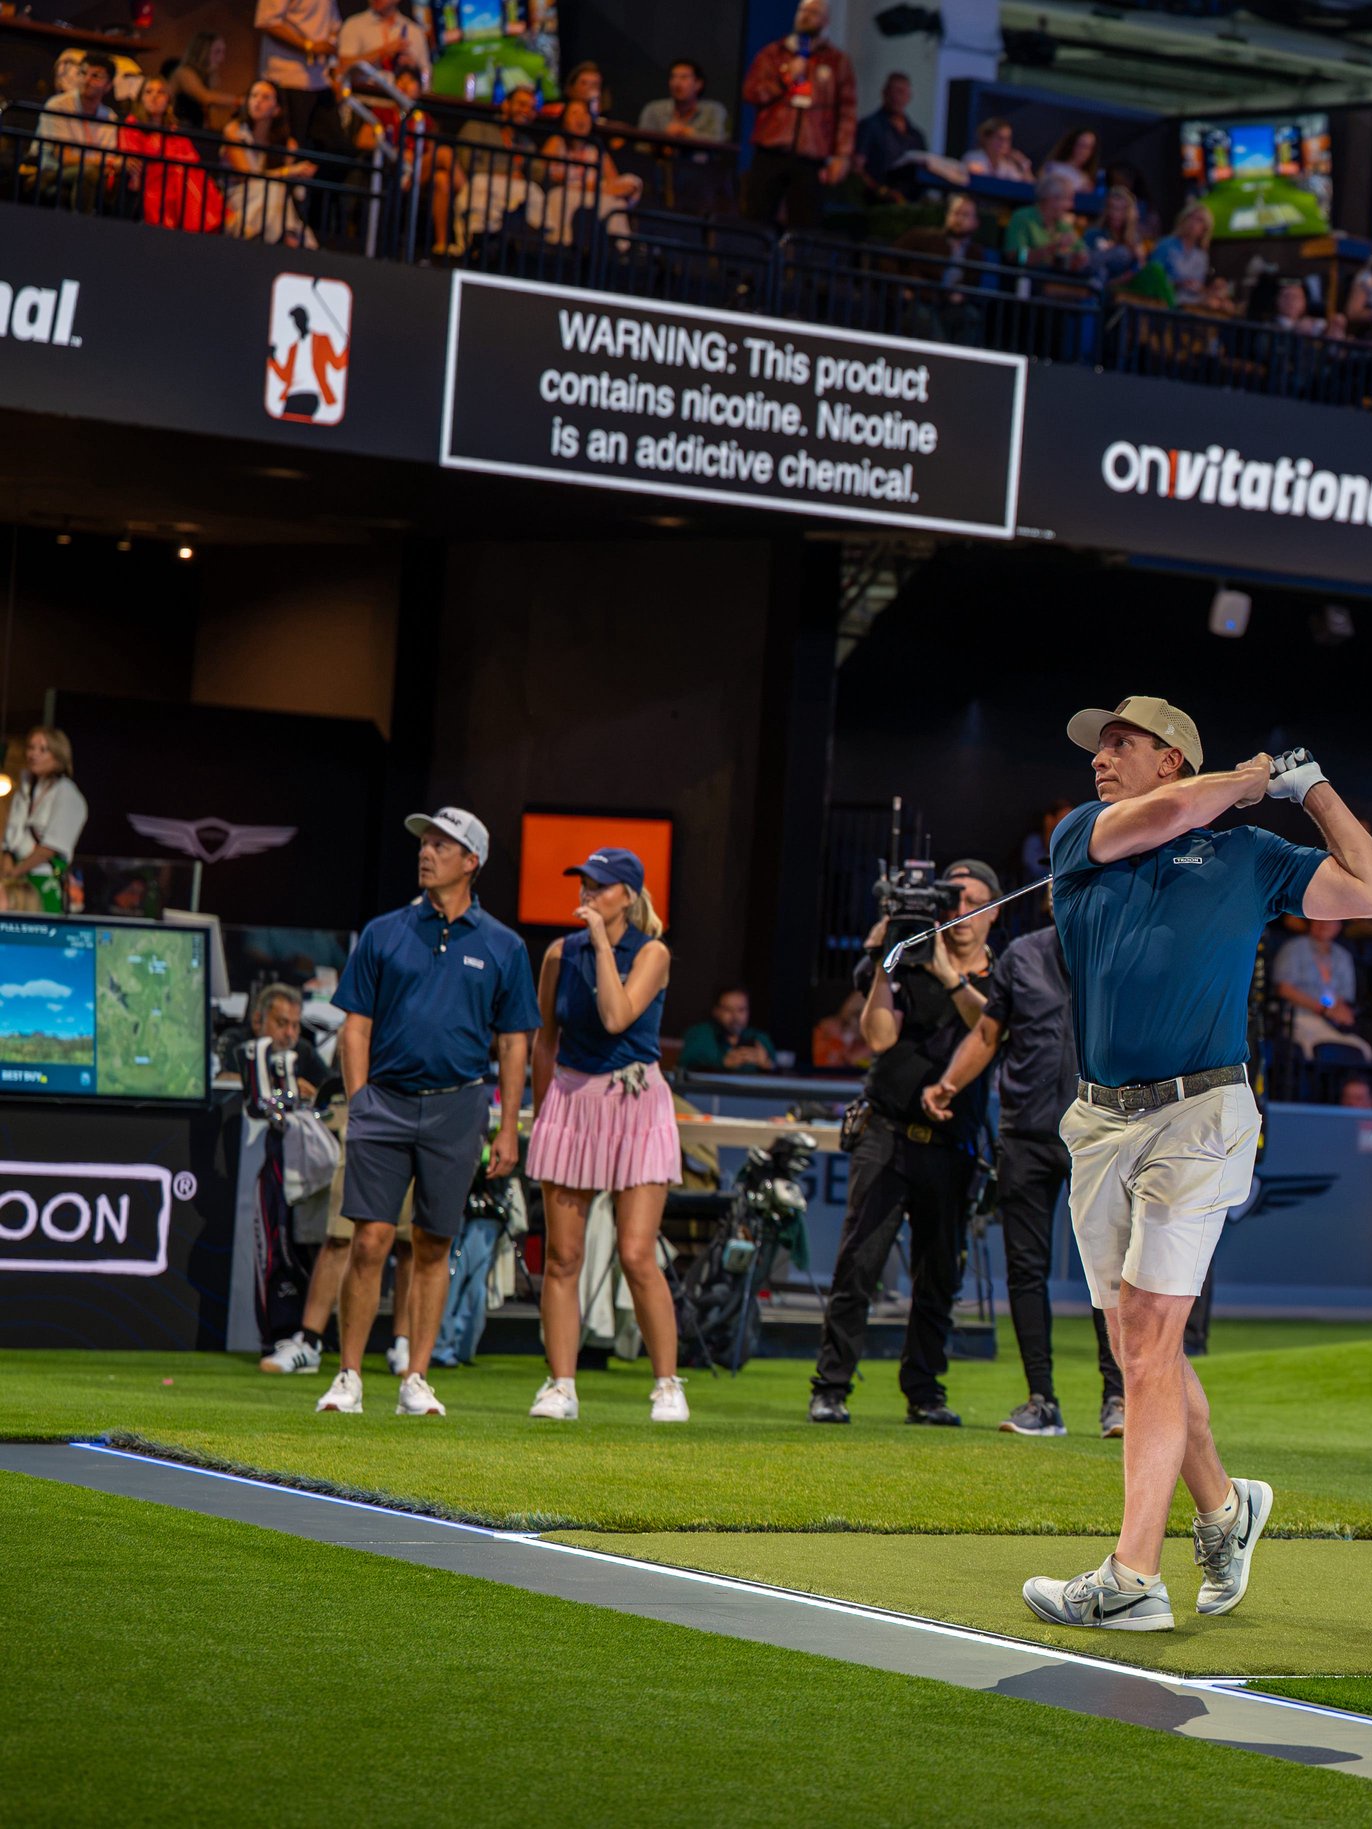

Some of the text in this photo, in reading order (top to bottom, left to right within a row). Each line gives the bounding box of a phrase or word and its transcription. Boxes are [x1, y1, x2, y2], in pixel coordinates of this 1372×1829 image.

[558, 309, 929, 402] WARNING: This product
[540, 369, 938, 454] contains nicotine. Nicotine
[551, 416, 919, 503] is an addictive chemical.
